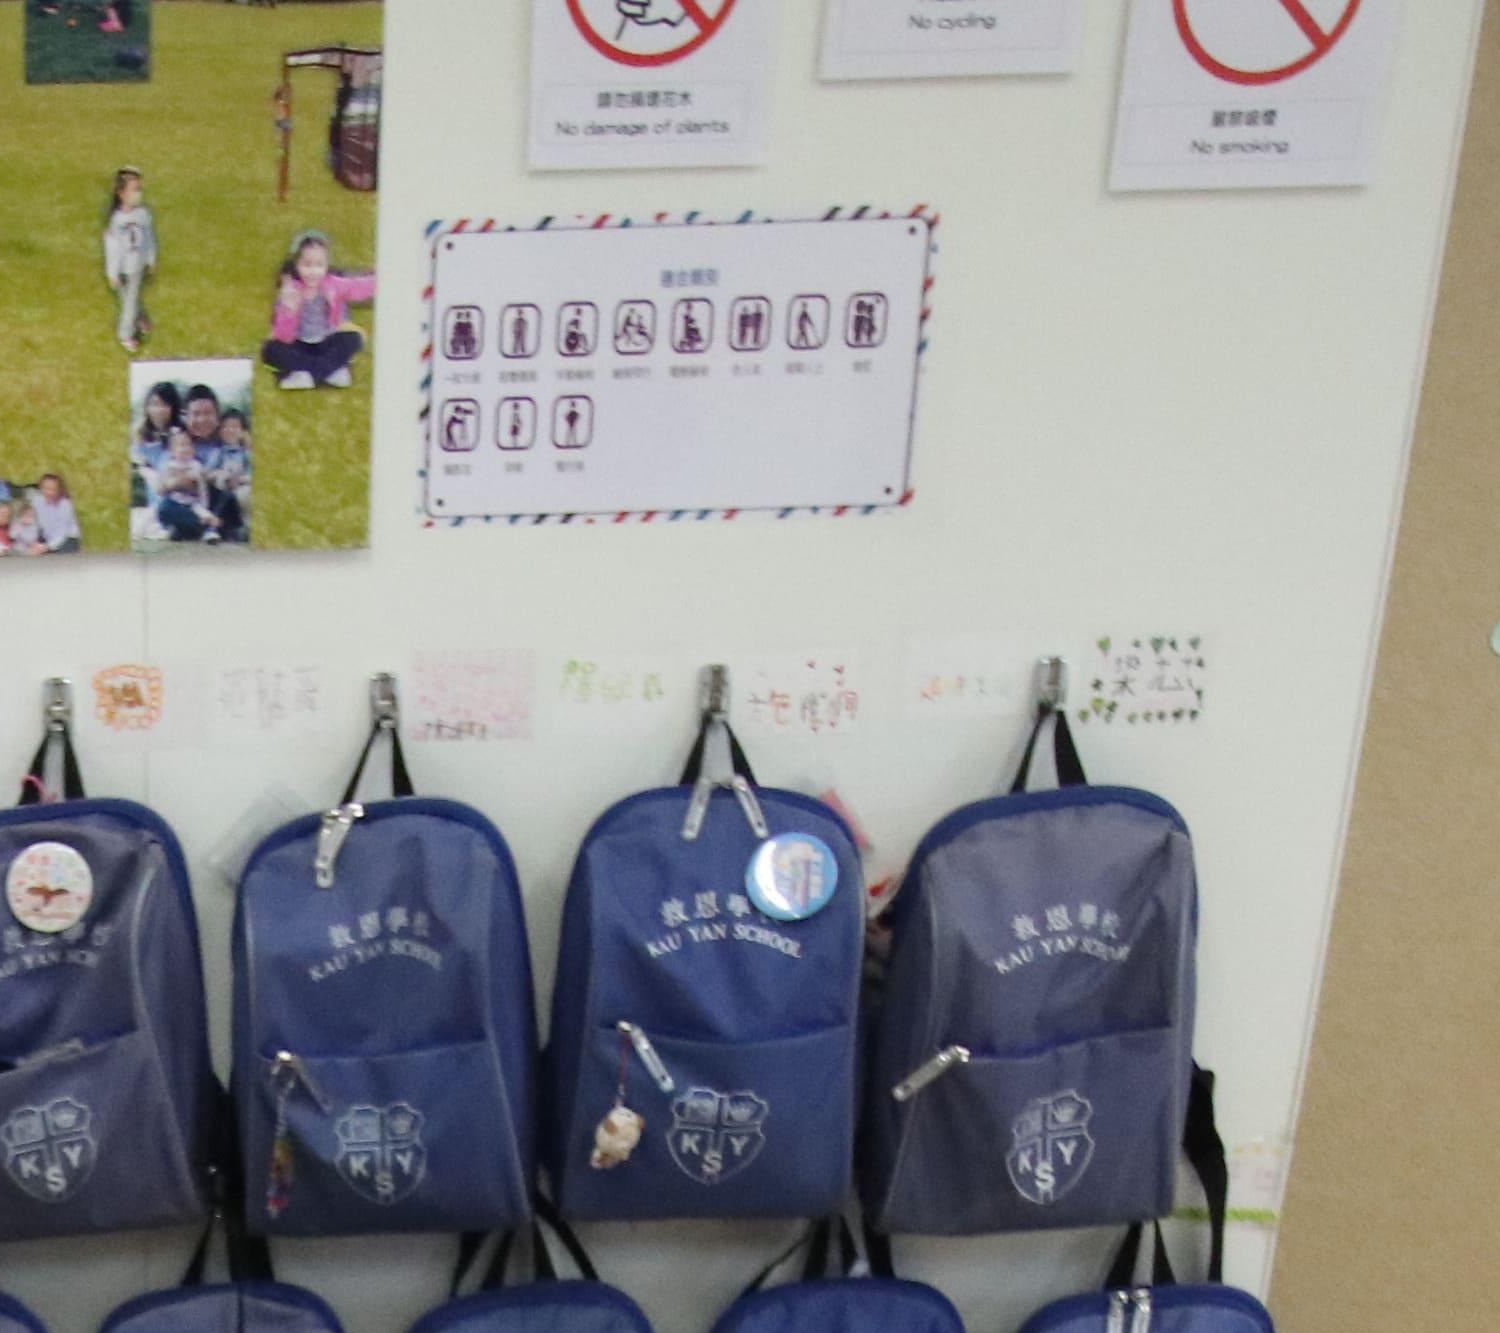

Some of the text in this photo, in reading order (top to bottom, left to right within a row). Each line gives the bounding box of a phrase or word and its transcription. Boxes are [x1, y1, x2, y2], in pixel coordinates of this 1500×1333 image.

[909, 14, 997, 32] No cycling
[556, 119, 730, 138] No damage of plants
[1190, 138, 1290, 155] No smoking
